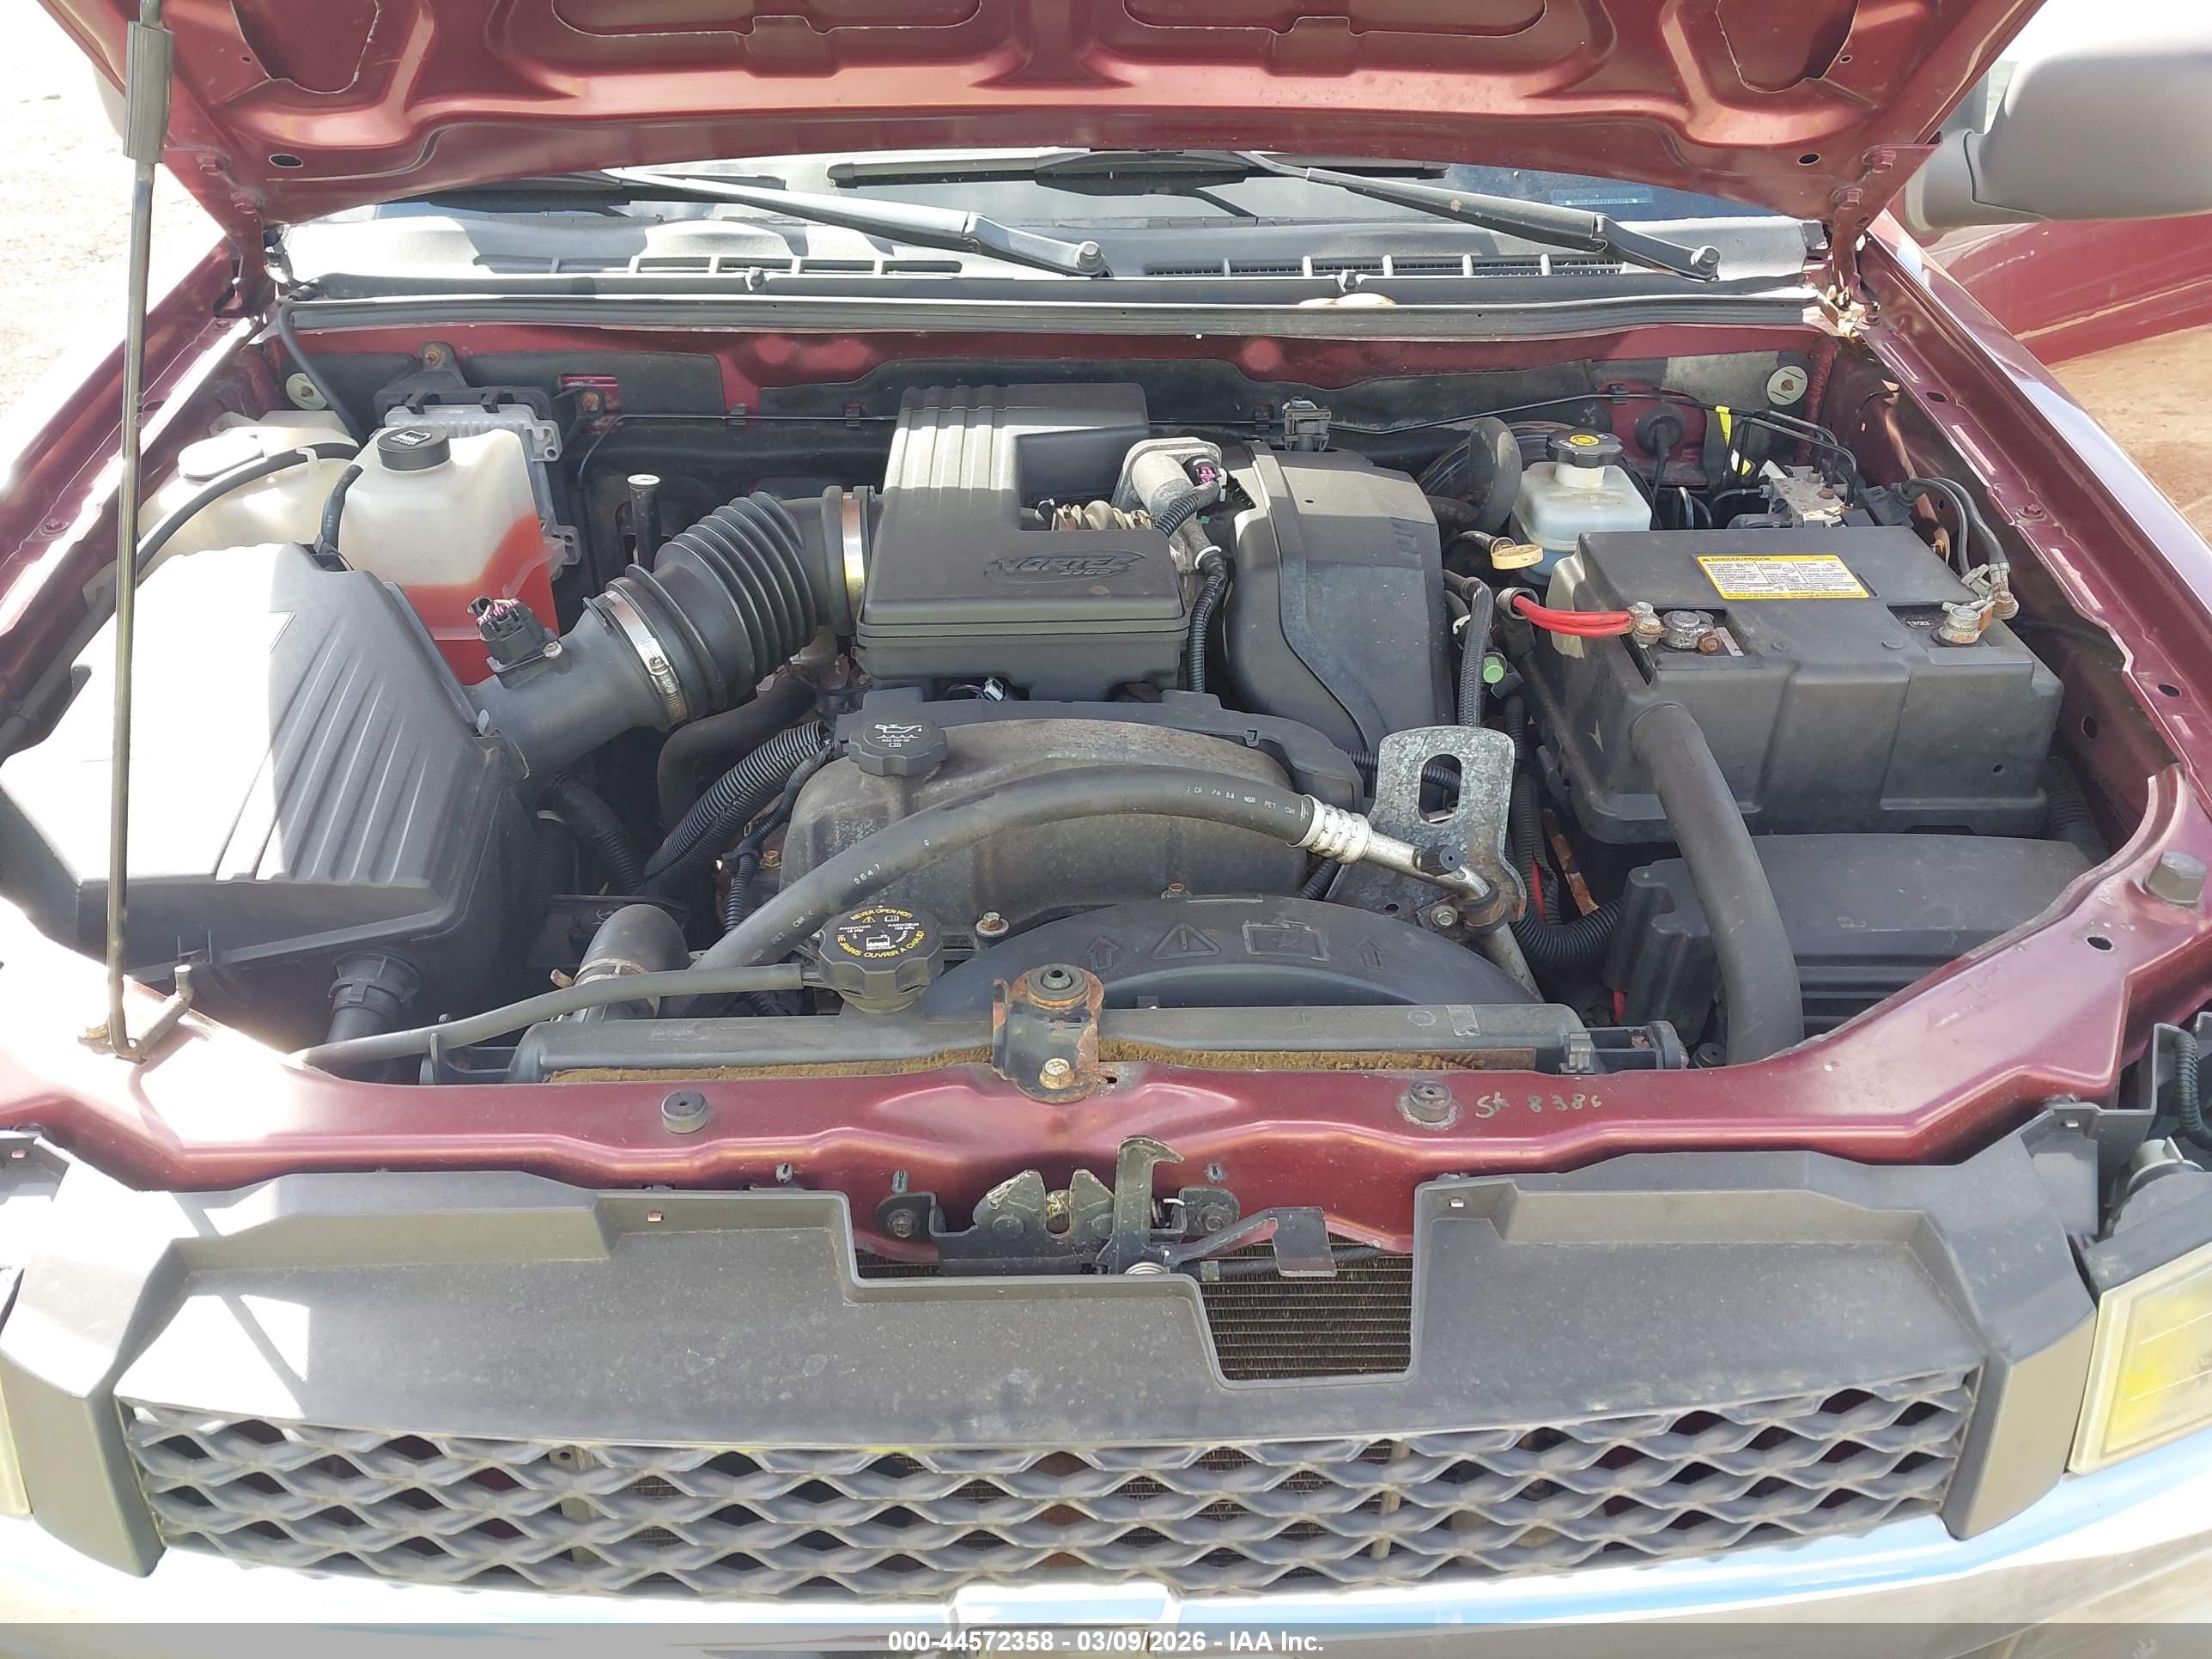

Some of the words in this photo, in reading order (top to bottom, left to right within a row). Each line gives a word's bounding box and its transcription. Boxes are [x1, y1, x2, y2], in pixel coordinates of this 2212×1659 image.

[849, 909, 875, 921] NEVER
[837, 933, 846, 943] NE
[839, 941, 863, 957] JAMAIS
[864, 950, 899, 958] OUVRIR
